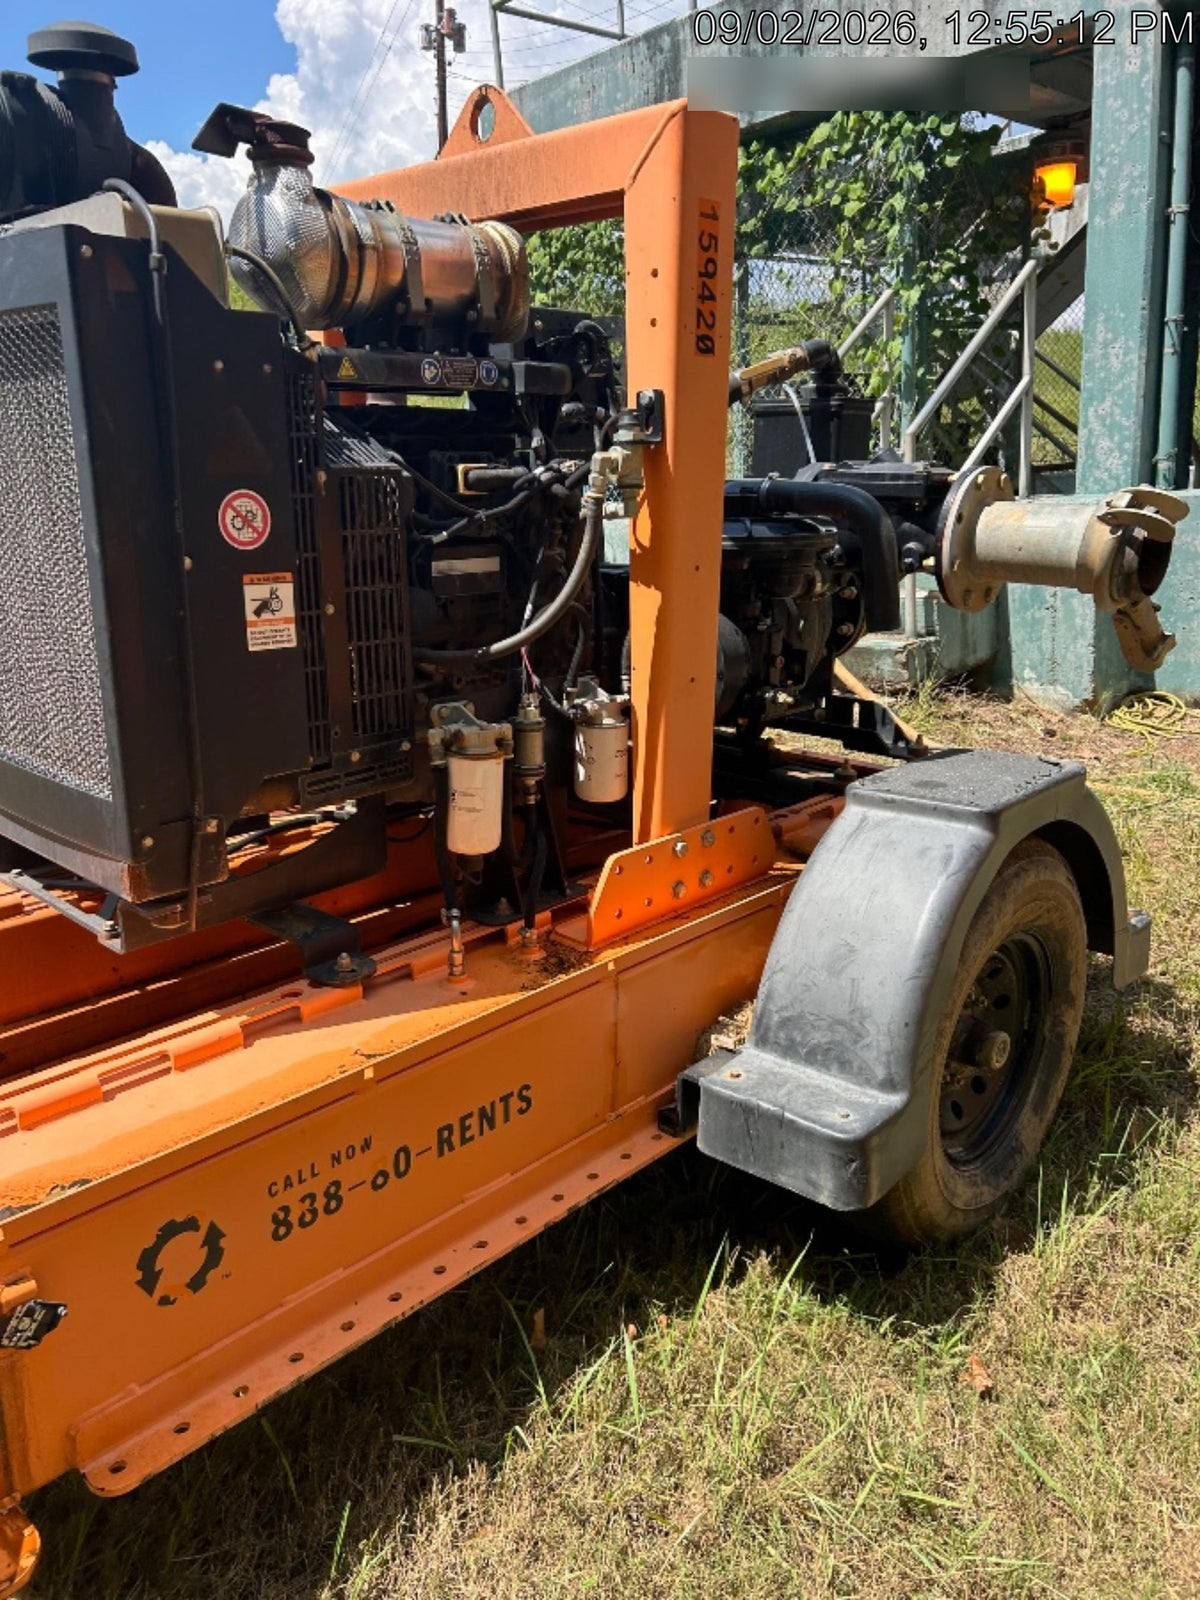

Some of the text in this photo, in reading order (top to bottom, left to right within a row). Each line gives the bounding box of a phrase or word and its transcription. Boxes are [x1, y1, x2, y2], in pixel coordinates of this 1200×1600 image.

[695, 204, 720, 356] 159420
[267, 1135, 373, 1198] CALL NOW
